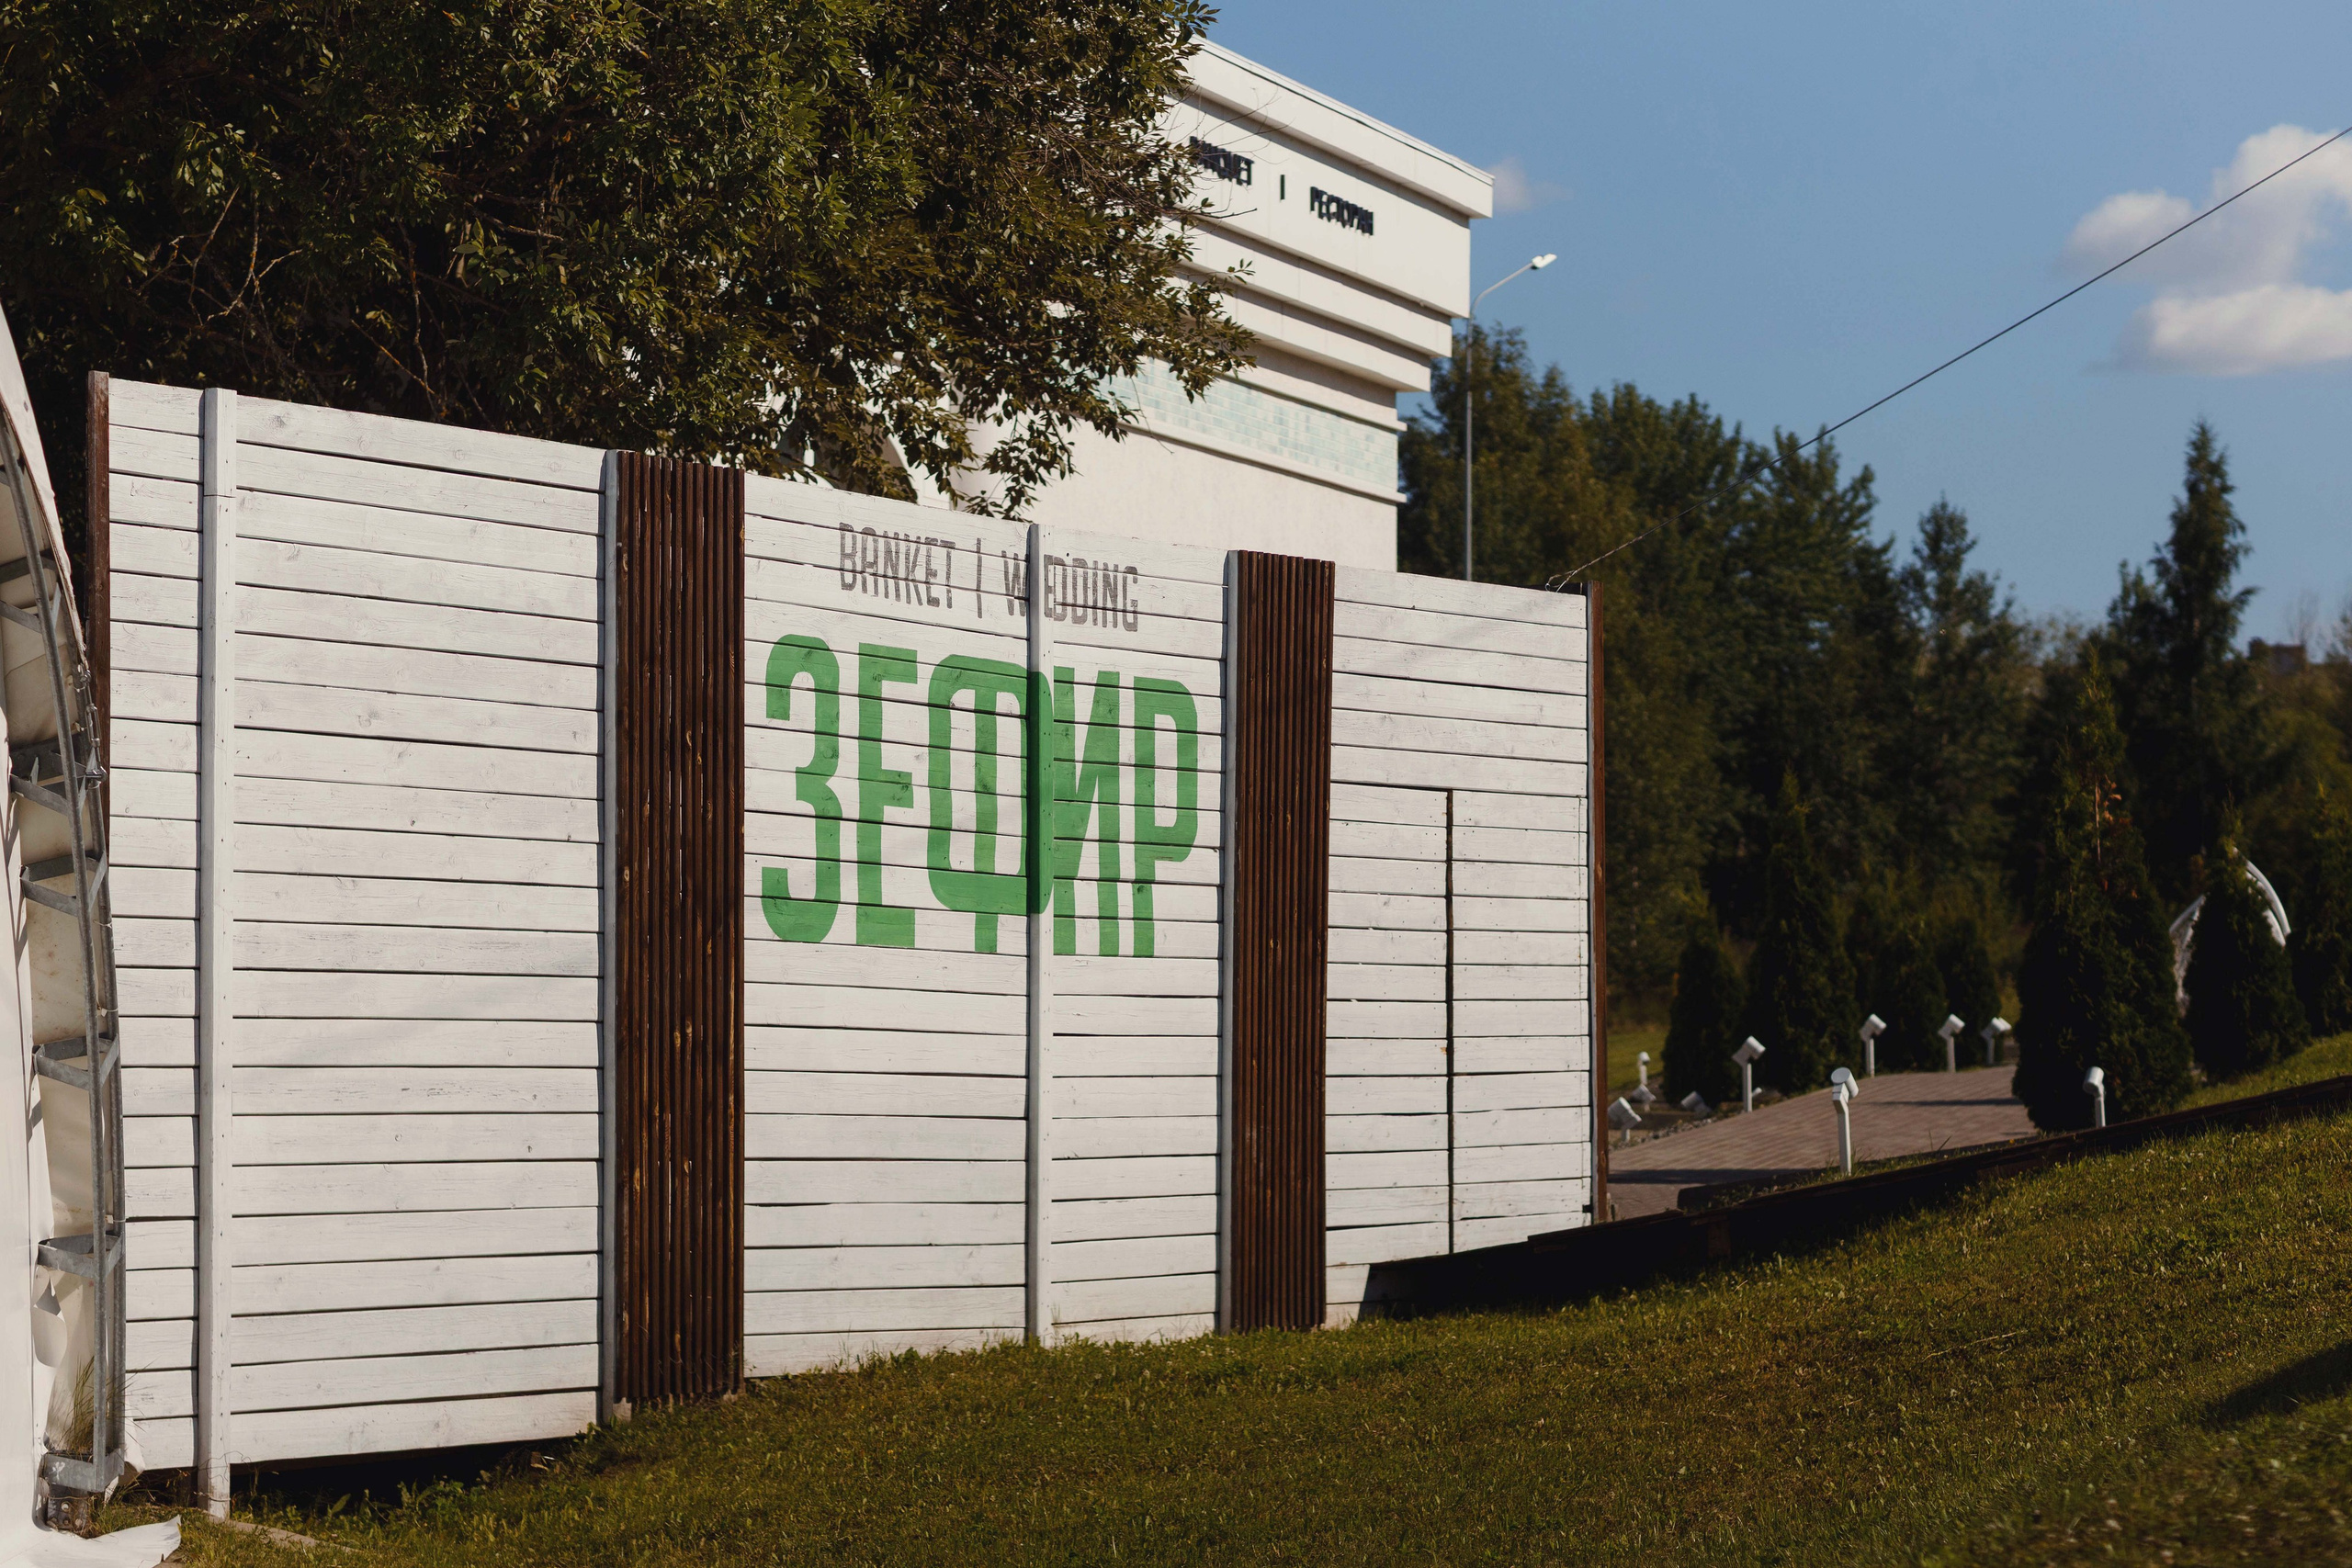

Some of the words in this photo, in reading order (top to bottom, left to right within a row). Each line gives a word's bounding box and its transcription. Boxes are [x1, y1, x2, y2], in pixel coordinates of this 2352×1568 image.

[838, 522, 956, 609] BANKET
[1001, 550, 1138, 632] WEDDING
[761, 633, 1198, 957] ЗЕФИР
